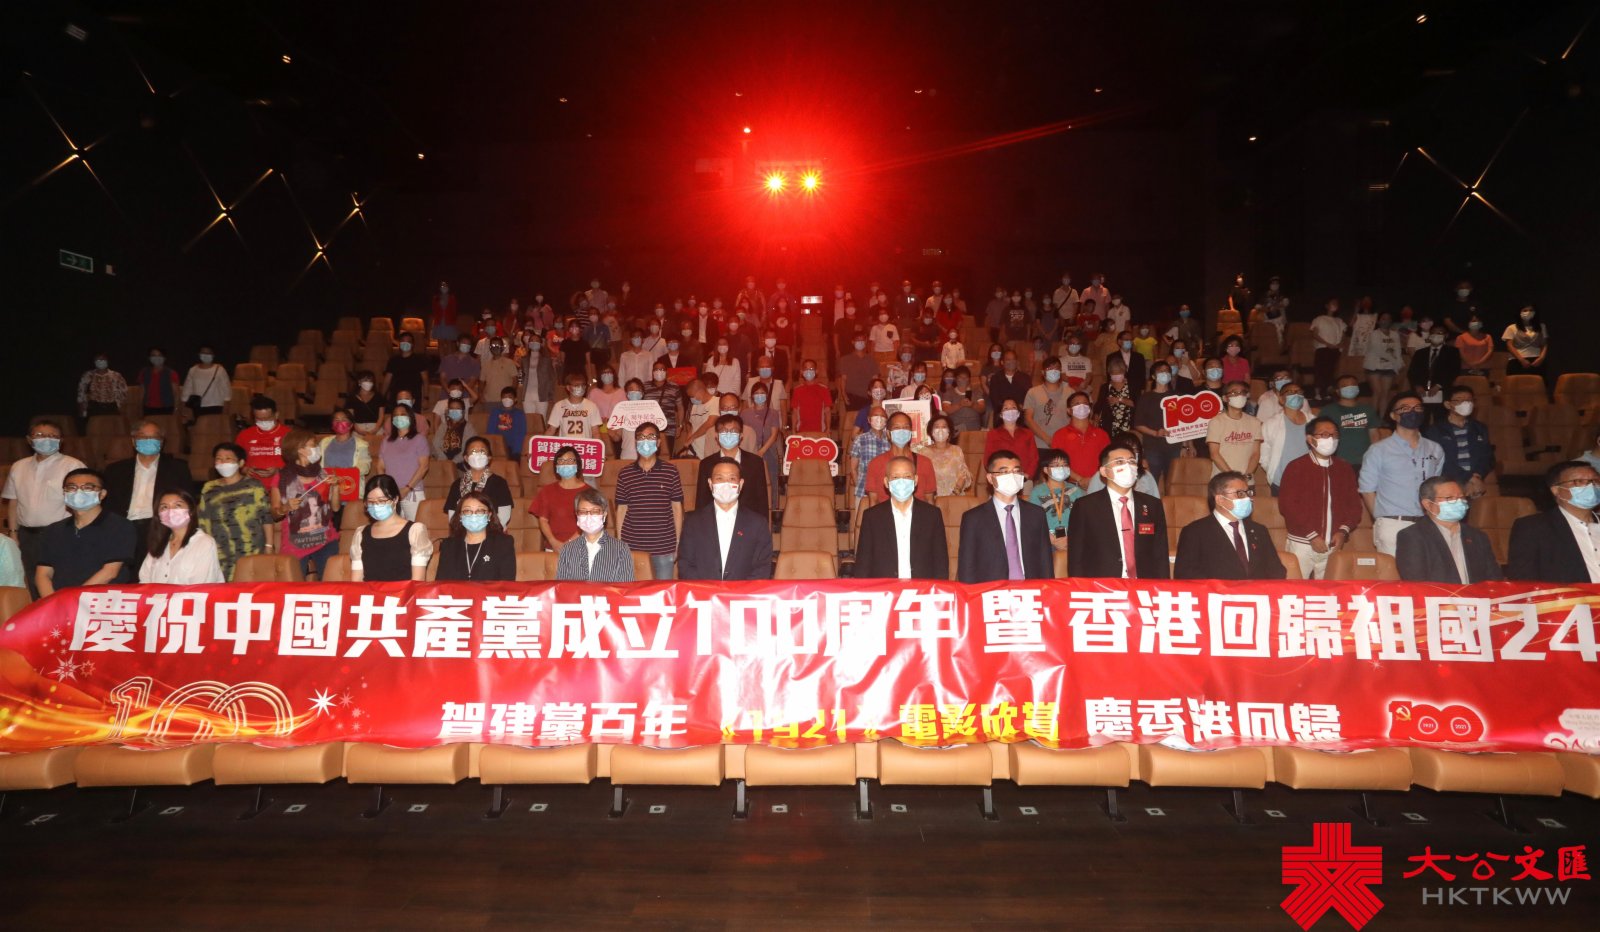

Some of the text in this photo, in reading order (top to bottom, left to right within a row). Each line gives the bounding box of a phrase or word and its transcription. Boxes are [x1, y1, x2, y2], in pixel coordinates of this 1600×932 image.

[562, 408, 588, 417] LAKERS
[567, 421, 583, 434] 23
[1069, 589, 1600, 662] 香港回歸祖國24
